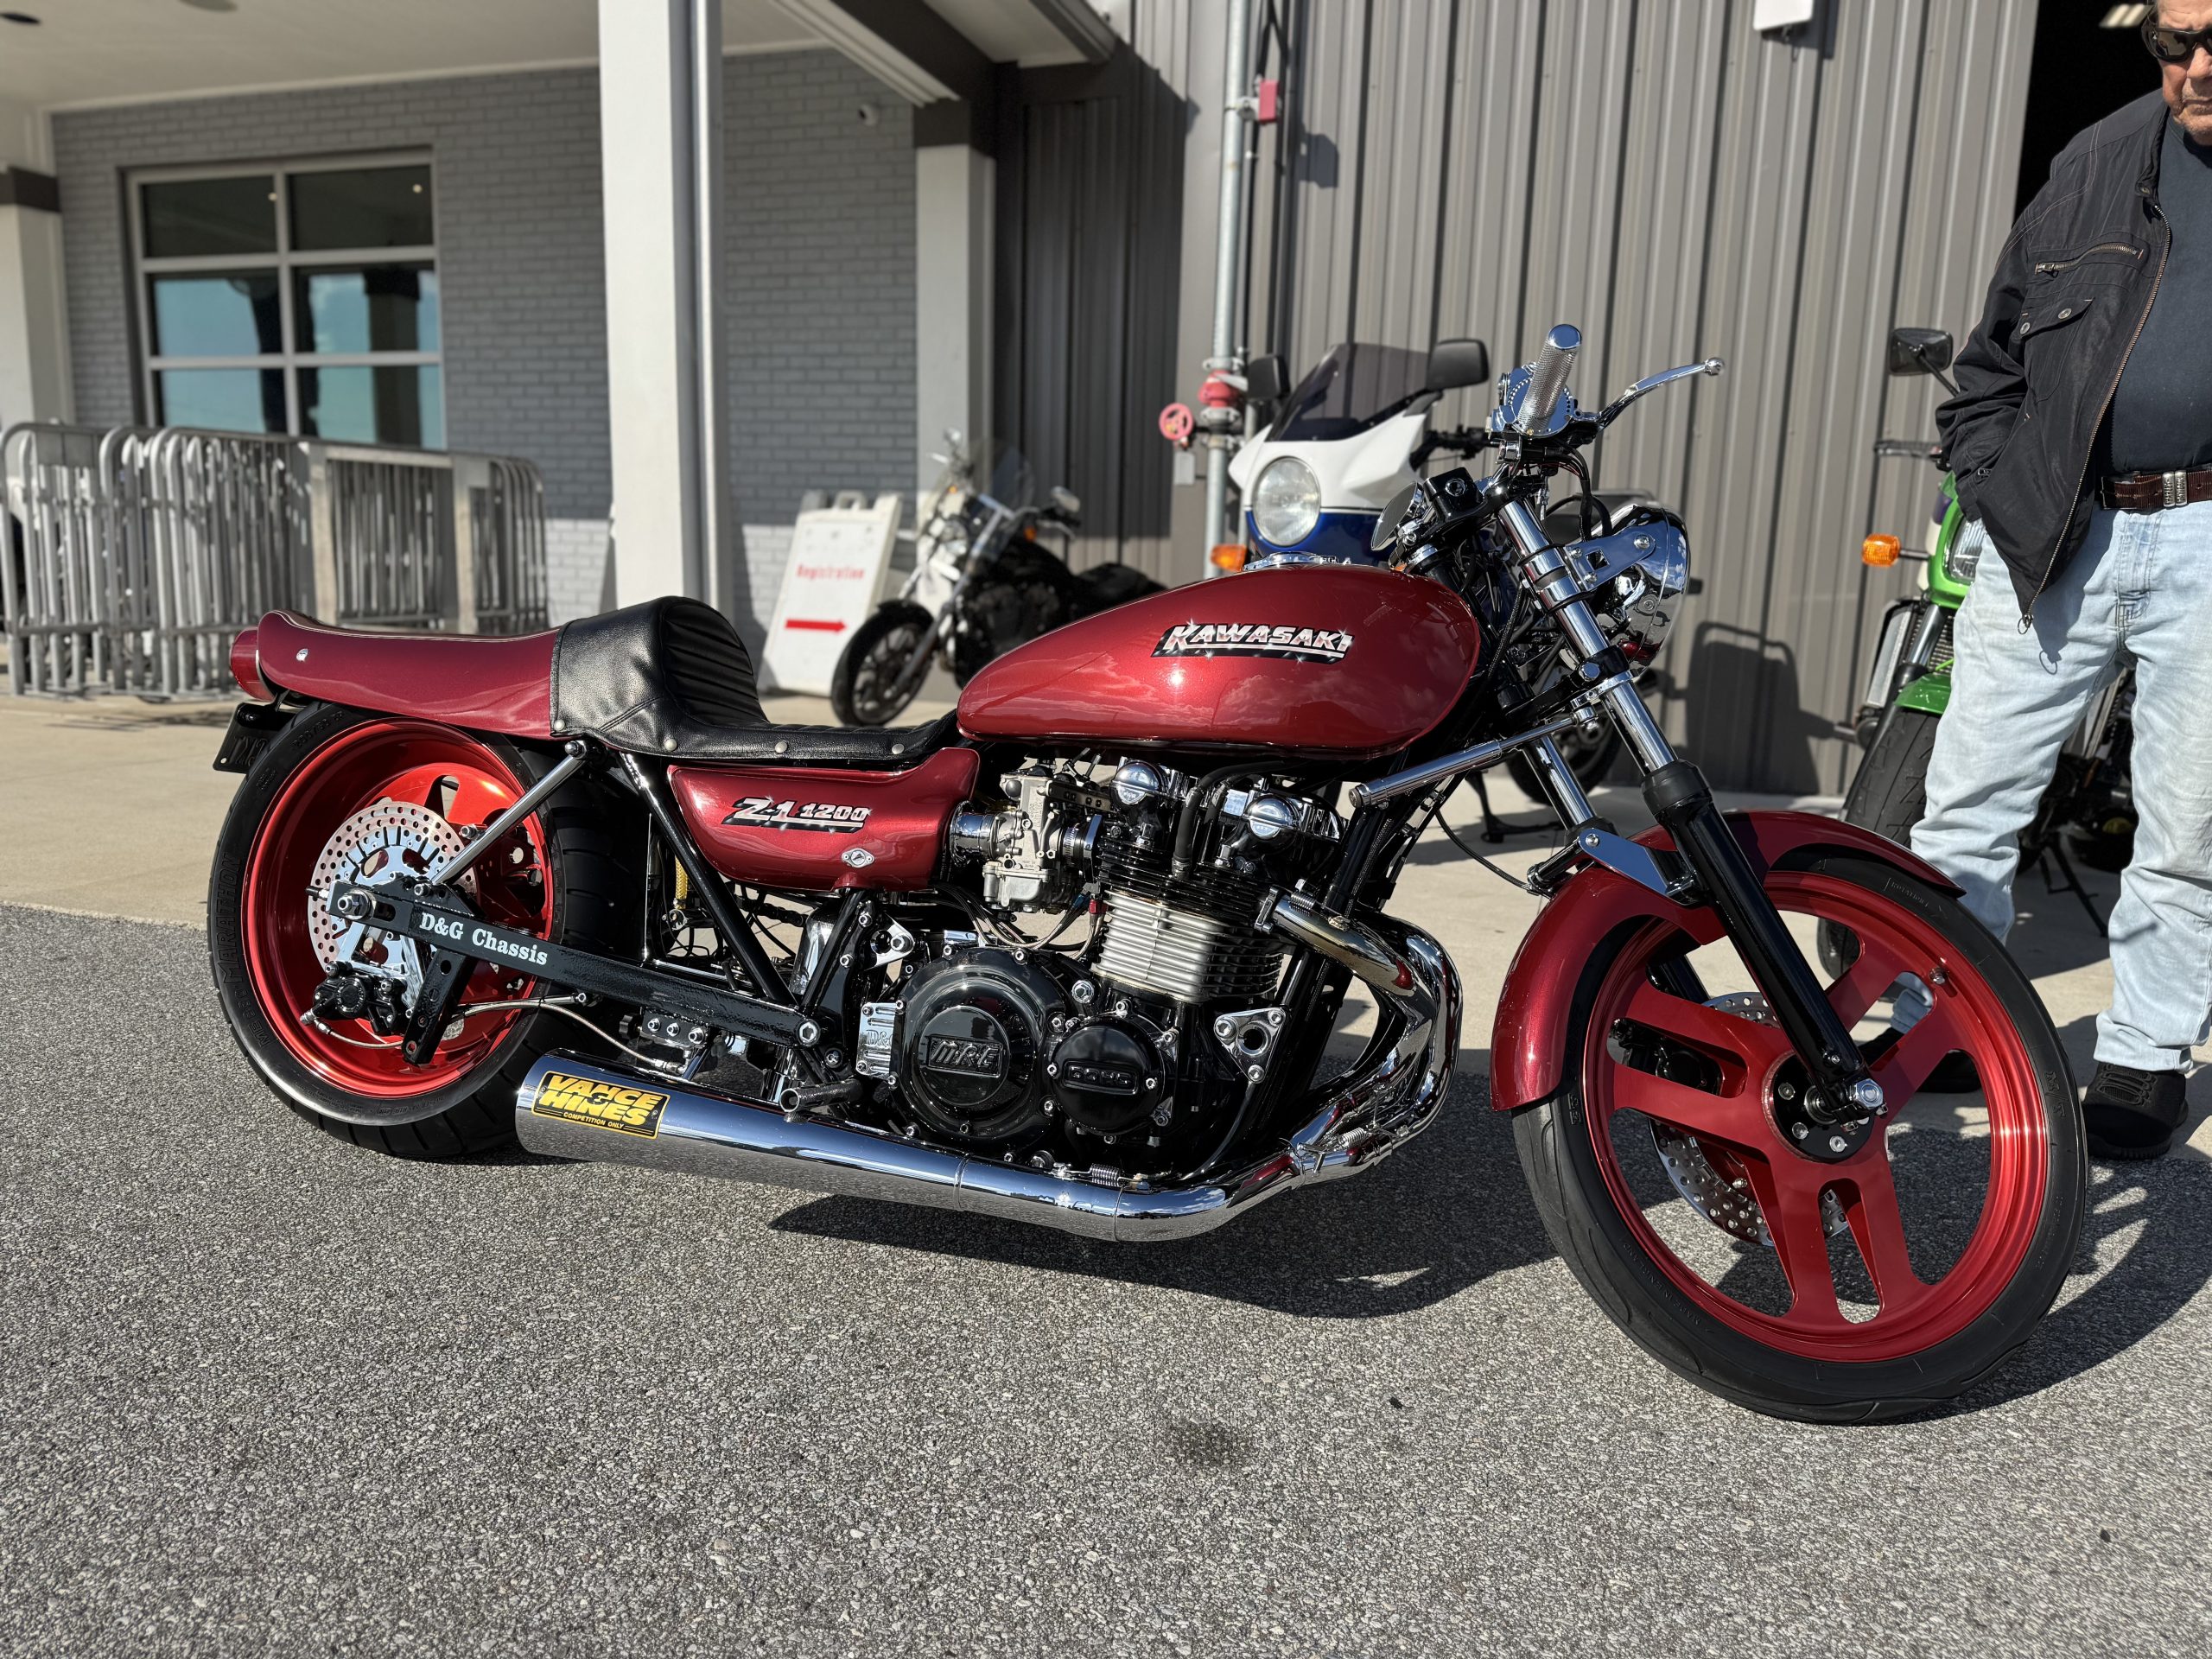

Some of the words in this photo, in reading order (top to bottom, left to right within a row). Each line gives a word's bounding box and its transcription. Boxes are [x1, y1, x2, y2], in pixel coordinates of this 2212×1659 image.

[1162, 624, 1354, 652] KAWASAKI
[799, 803, 870, 821] 1200
[215, 852, 244, 984] MARATHON
[419, 912, 464, 940] D&G
[472, 927, 549, 966] Chassis
[538, 1090, 650, 1126] HINES
[547, 1075, 662, 1110] VANCE
[563, 1112, 607, 1126] COMPETITION
[607, 1121, 624, 1129] ONLY
